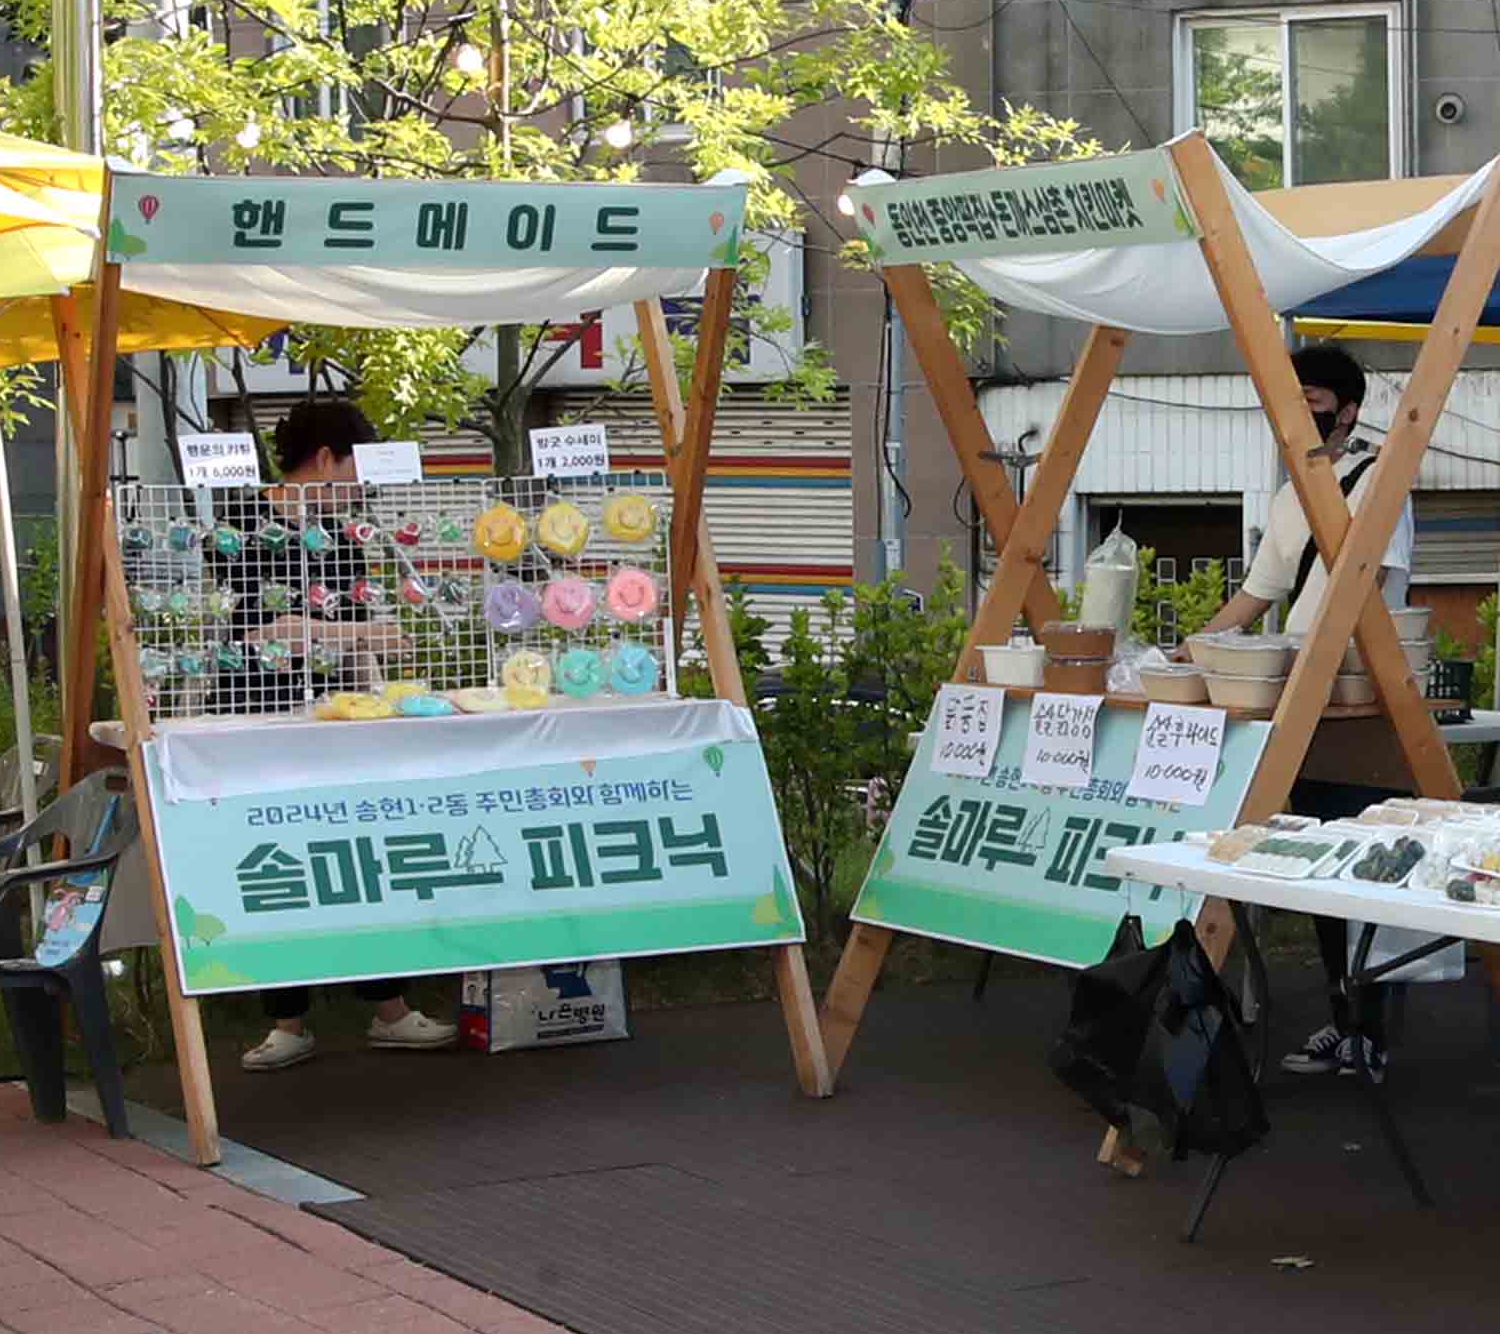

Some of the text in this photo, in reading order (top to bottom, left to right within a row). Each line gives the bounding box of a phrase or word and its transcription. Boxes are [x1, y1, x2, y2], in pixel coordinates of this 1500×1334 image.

[233, 199, 638, 251] 핸드메이드
[247, 801, 348, 827] 2024년
[475, 785, 595, 815] 주민총회와
[600, 778, 693, 806] 함께하는
[908, 795, 1037, 870] 솔마루
[236, 813, 729, 914] 솔마루 피크닉
